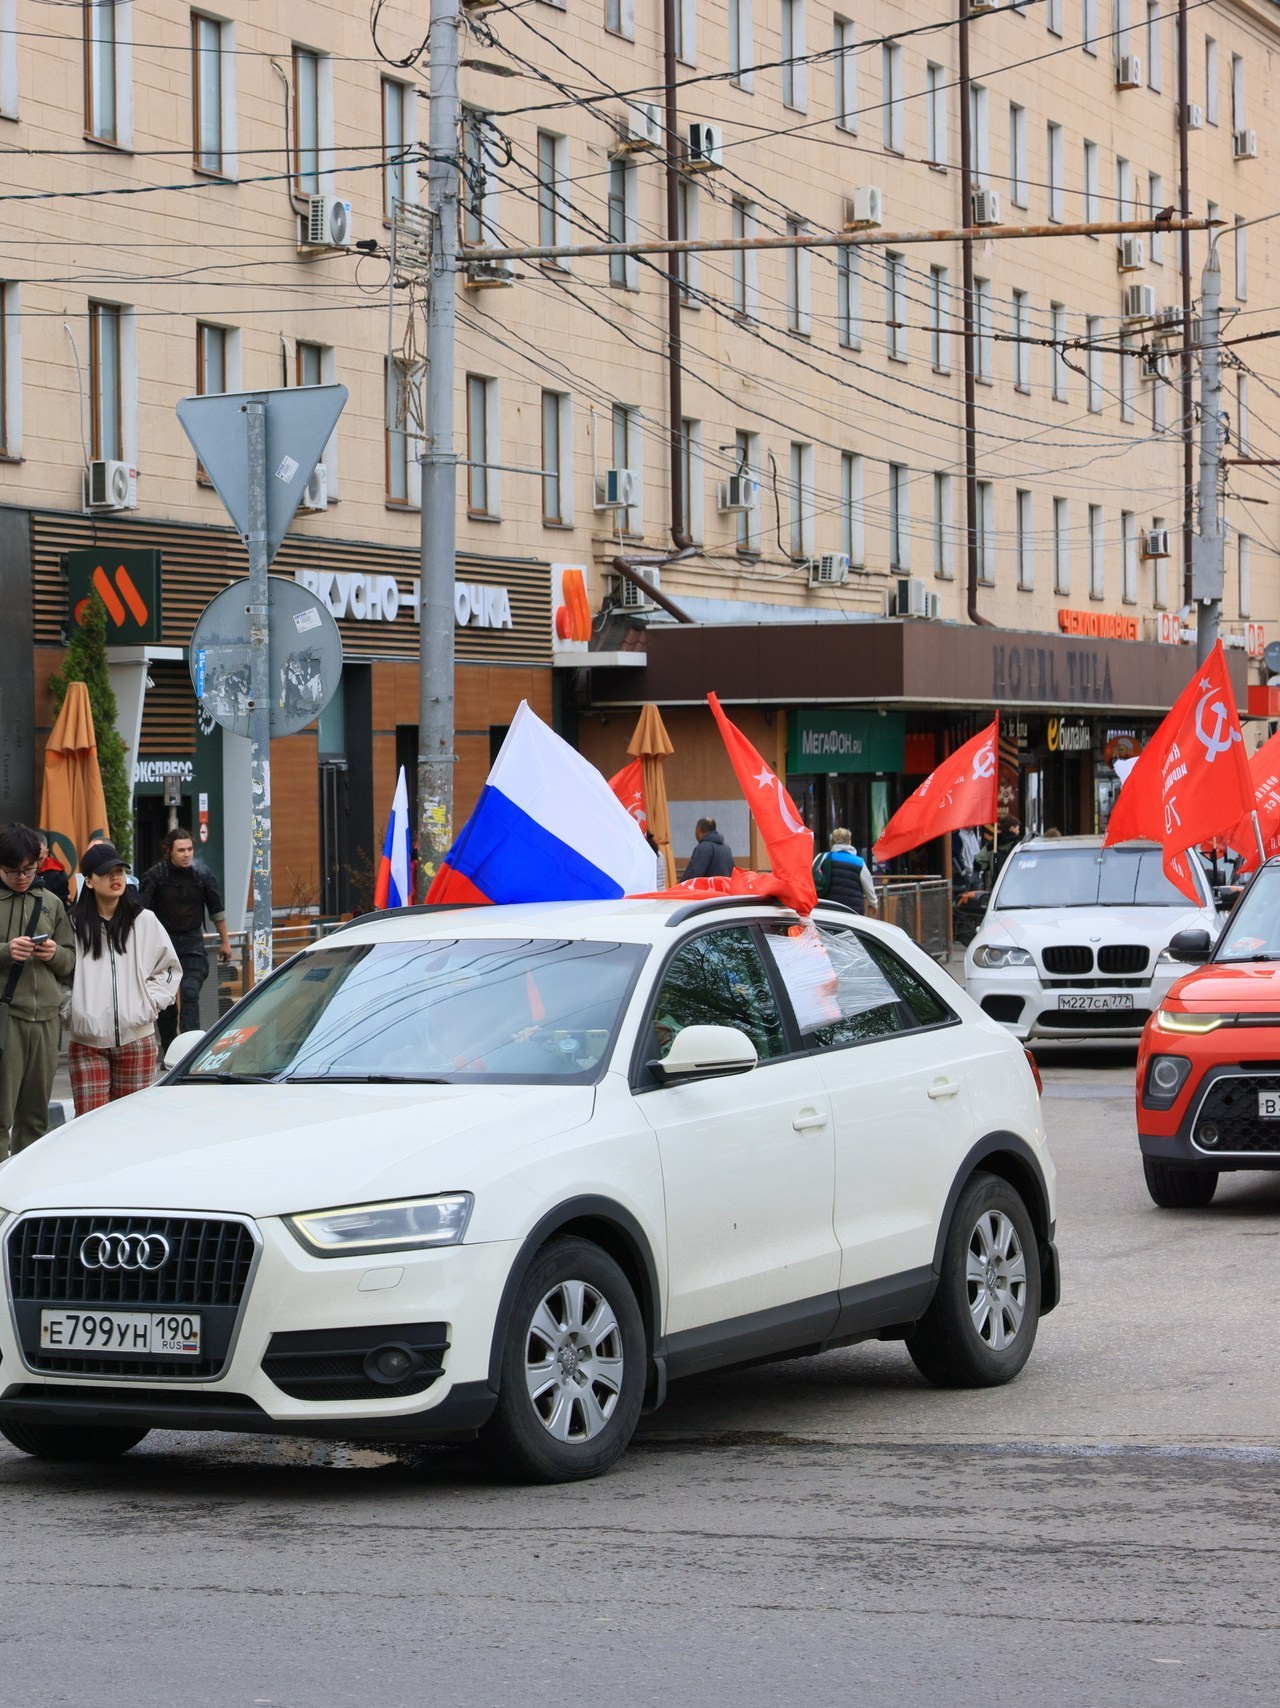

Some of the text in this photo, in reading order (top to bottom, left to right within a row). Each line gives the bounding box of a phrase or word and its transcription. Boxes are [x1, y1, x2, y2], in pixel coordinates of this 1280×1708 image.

[455, 582, 513, 629] ОЧКА
[1098, 613, 1139, 640] МАРКЕТ
[1067, 651, 1113, 703] TULA
[1059, 717, 1090, 751] билайн
[1062, 997, 1109, 1009] М227СА
[1266, 1095, 1280, 1114] В
[50, 1315, 193, 1348] Е799УН 190
[162, 1341, 182, 1350] RUS
